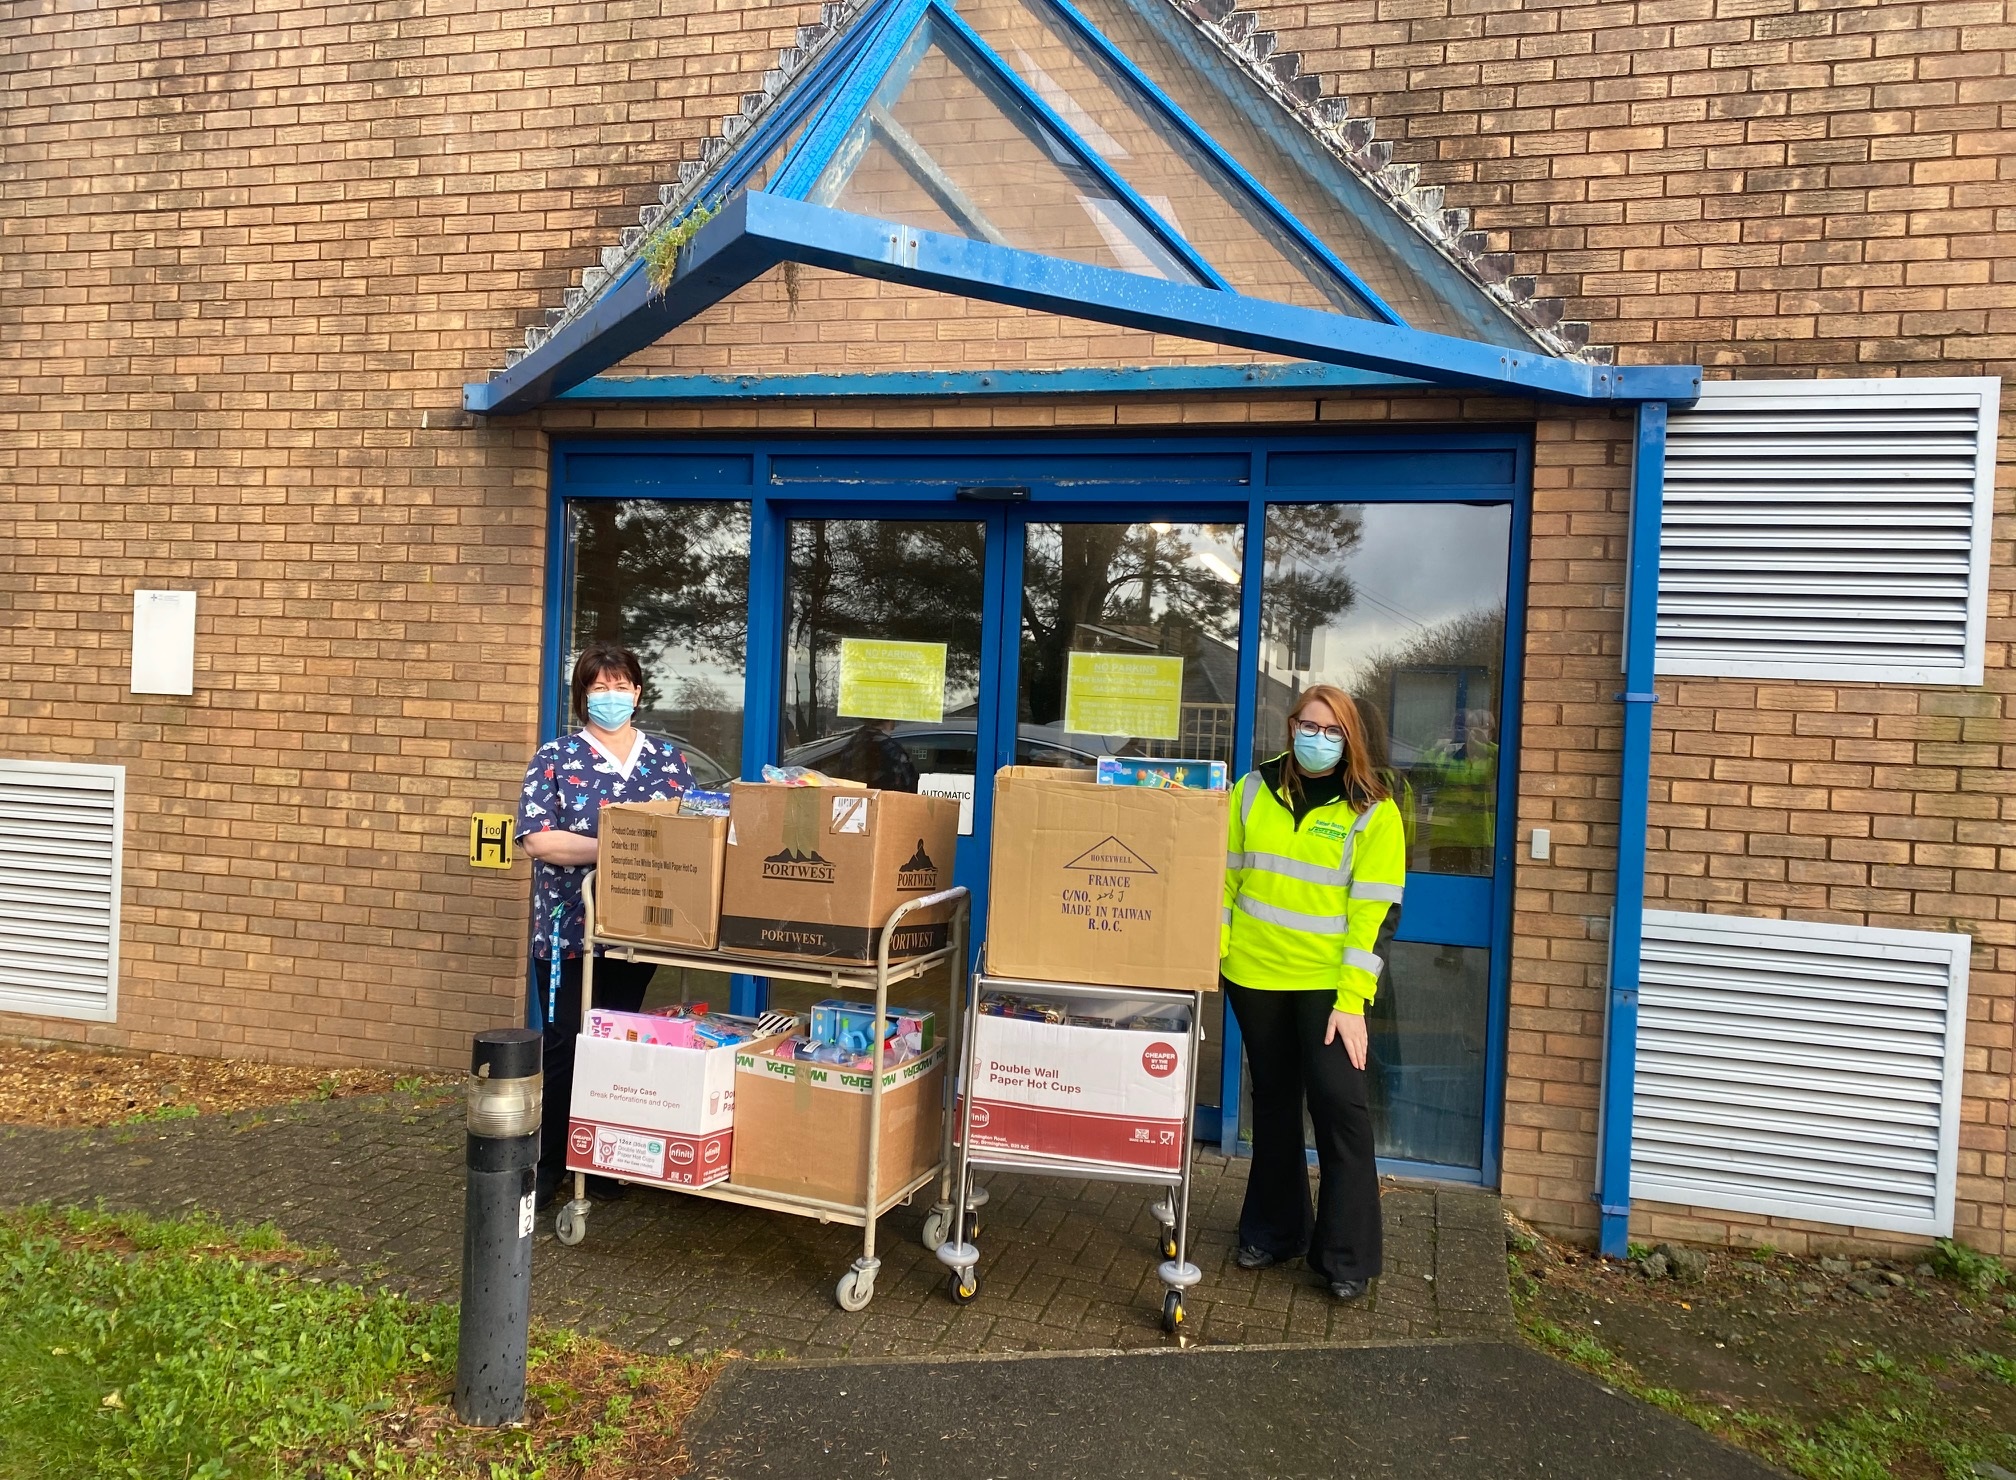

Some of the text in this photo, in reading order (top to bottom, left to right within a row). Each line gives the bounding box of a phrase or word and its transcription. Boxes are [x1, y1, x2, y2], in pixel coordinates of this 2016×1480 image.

[865, 649, 879, 658] NO
[1094, 663, 1157, 674] NO PARKING
[921, 789, 971, 800] AUTOMATIC
[485, 827, 500, 835] 100
[476, 819, 507, 863] H
[1090, 854, 1133, 864] HONEYWELL
[672, 862, 683, 872] Paper
[690, 864, 698, 874] Cup
[763, 863, 834, 879] PORTWEST
[897, 873, 938, 887] PORTWEST
[1088, 874, 1131, 888] FRANCE
[1062, 889, 1091, 902] C/NO.
[1061, 903, 1152, 921] MADE IN TAIWAN
[761, 929, 825, 946] PORTWEST
[1145, 1052, 1176, 1060] CHEAPER
[990, 1061, 1059, 1079] Double Wall
[613, 1084, 657, 1096] Display Case
[989, 1073, 1081, 1094] Paper Hot Cups
[590, 1090, 608, 1099] Break
[609, 1093, 648, 1105] Perforations
[662, 1100, 681, 1109] Open
